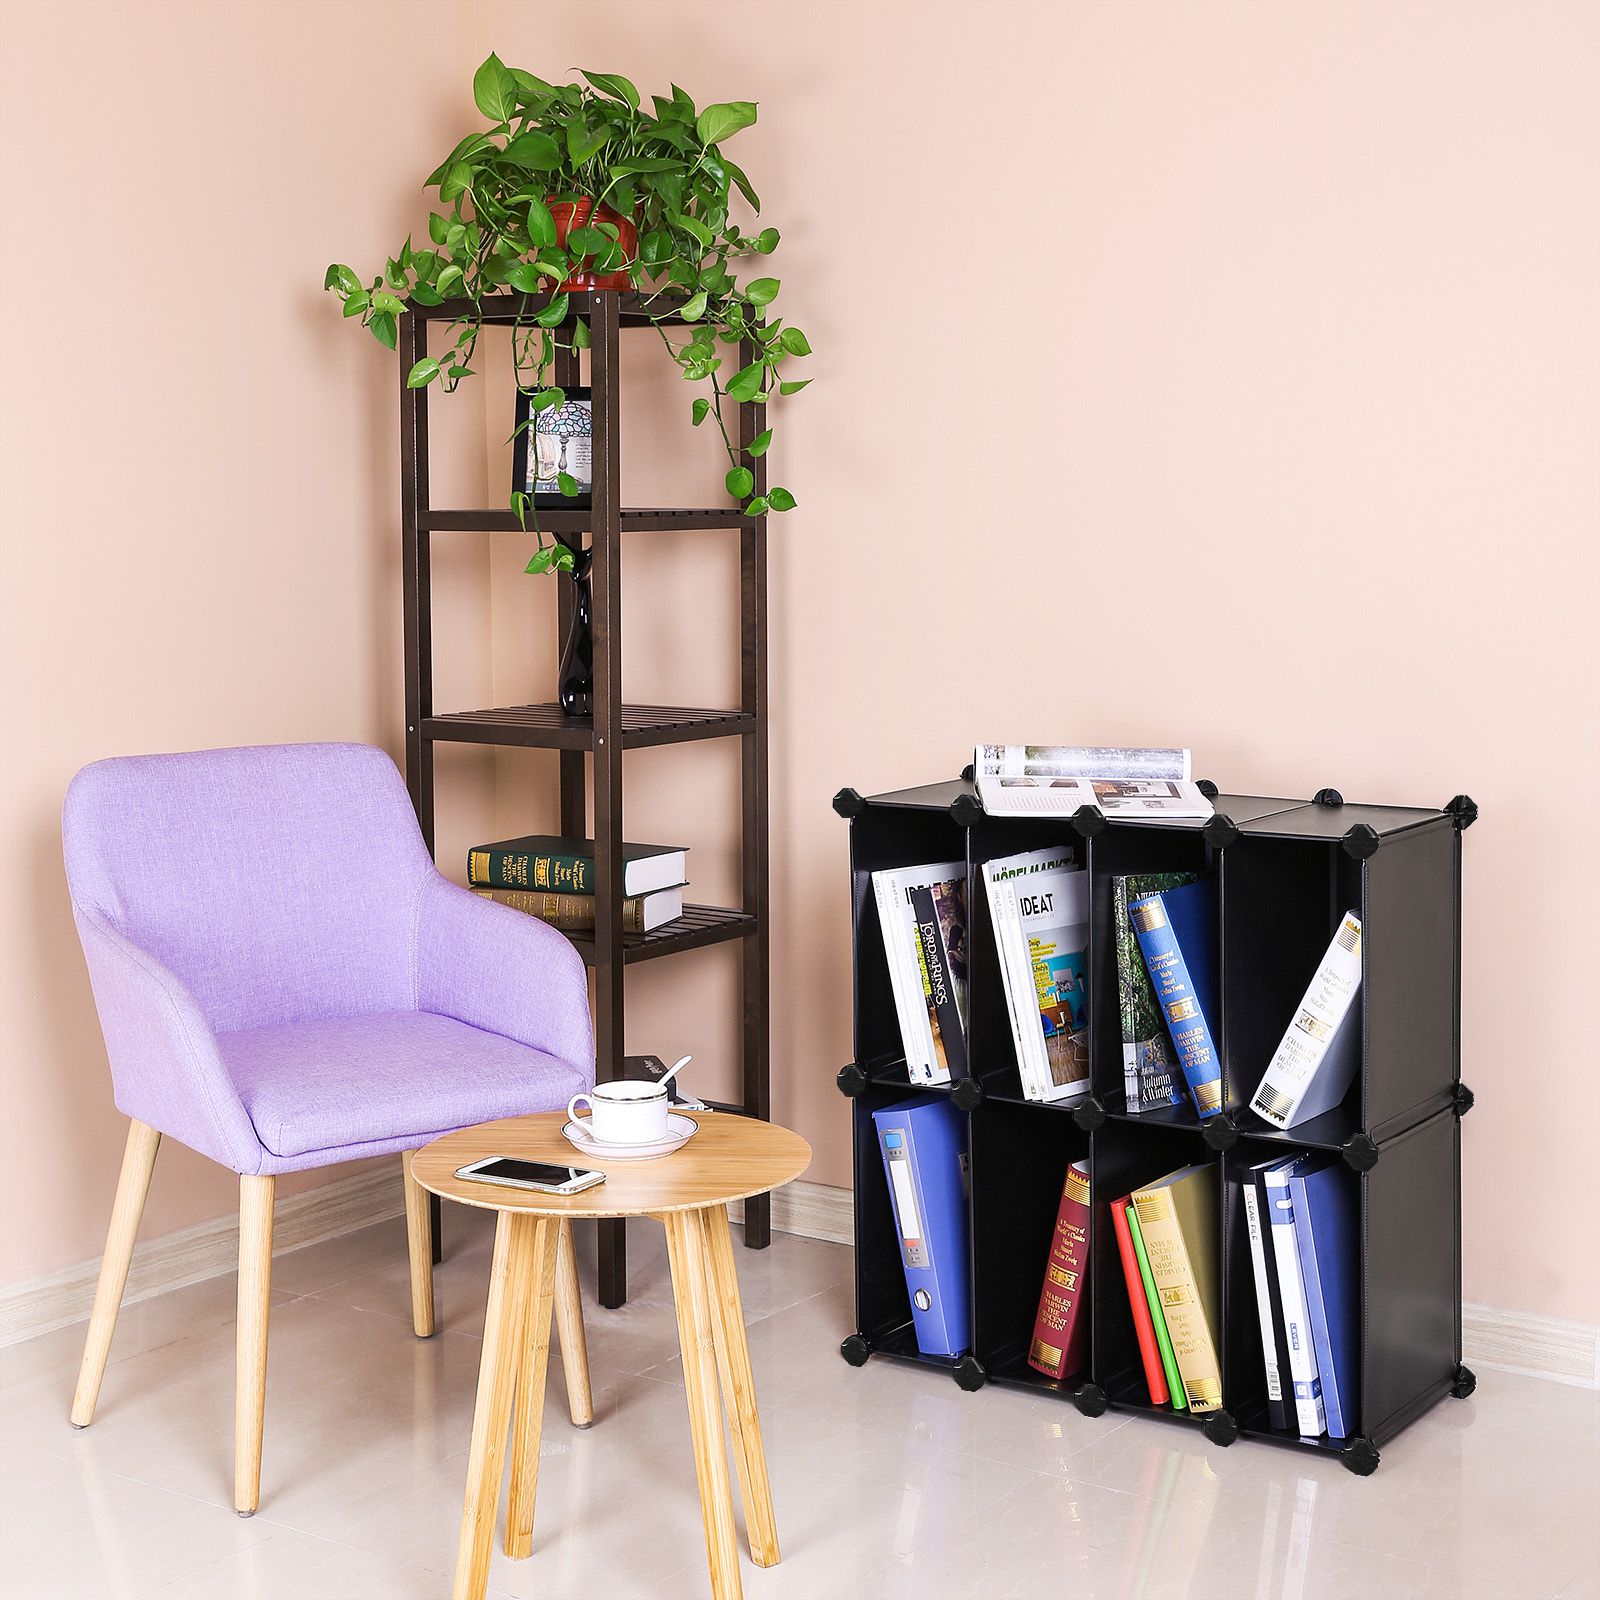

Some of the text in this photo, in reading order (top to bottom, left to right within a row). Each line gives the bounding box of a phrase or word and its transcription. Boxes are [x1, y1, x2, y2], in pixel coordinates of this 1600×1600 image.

[1020, 893, 1053, 917] IDEAT
[920, 921, 937, 955] LORD
[932, 963, 948, 1005] RINGS
[1175, 1026, 1204, 1039] CHARLES
[1185, 1043, 1200, 1053] THE
[1194, 1055, 1210, 1066] MAN
[1143, 1074, 1171, 1089] Autumn
[1246, 1193, 1258, 1241] CLEAR FILE
[1047, 1305, 1061, 1317] THE
[1047, 1320, 1064, 1332] MAN
